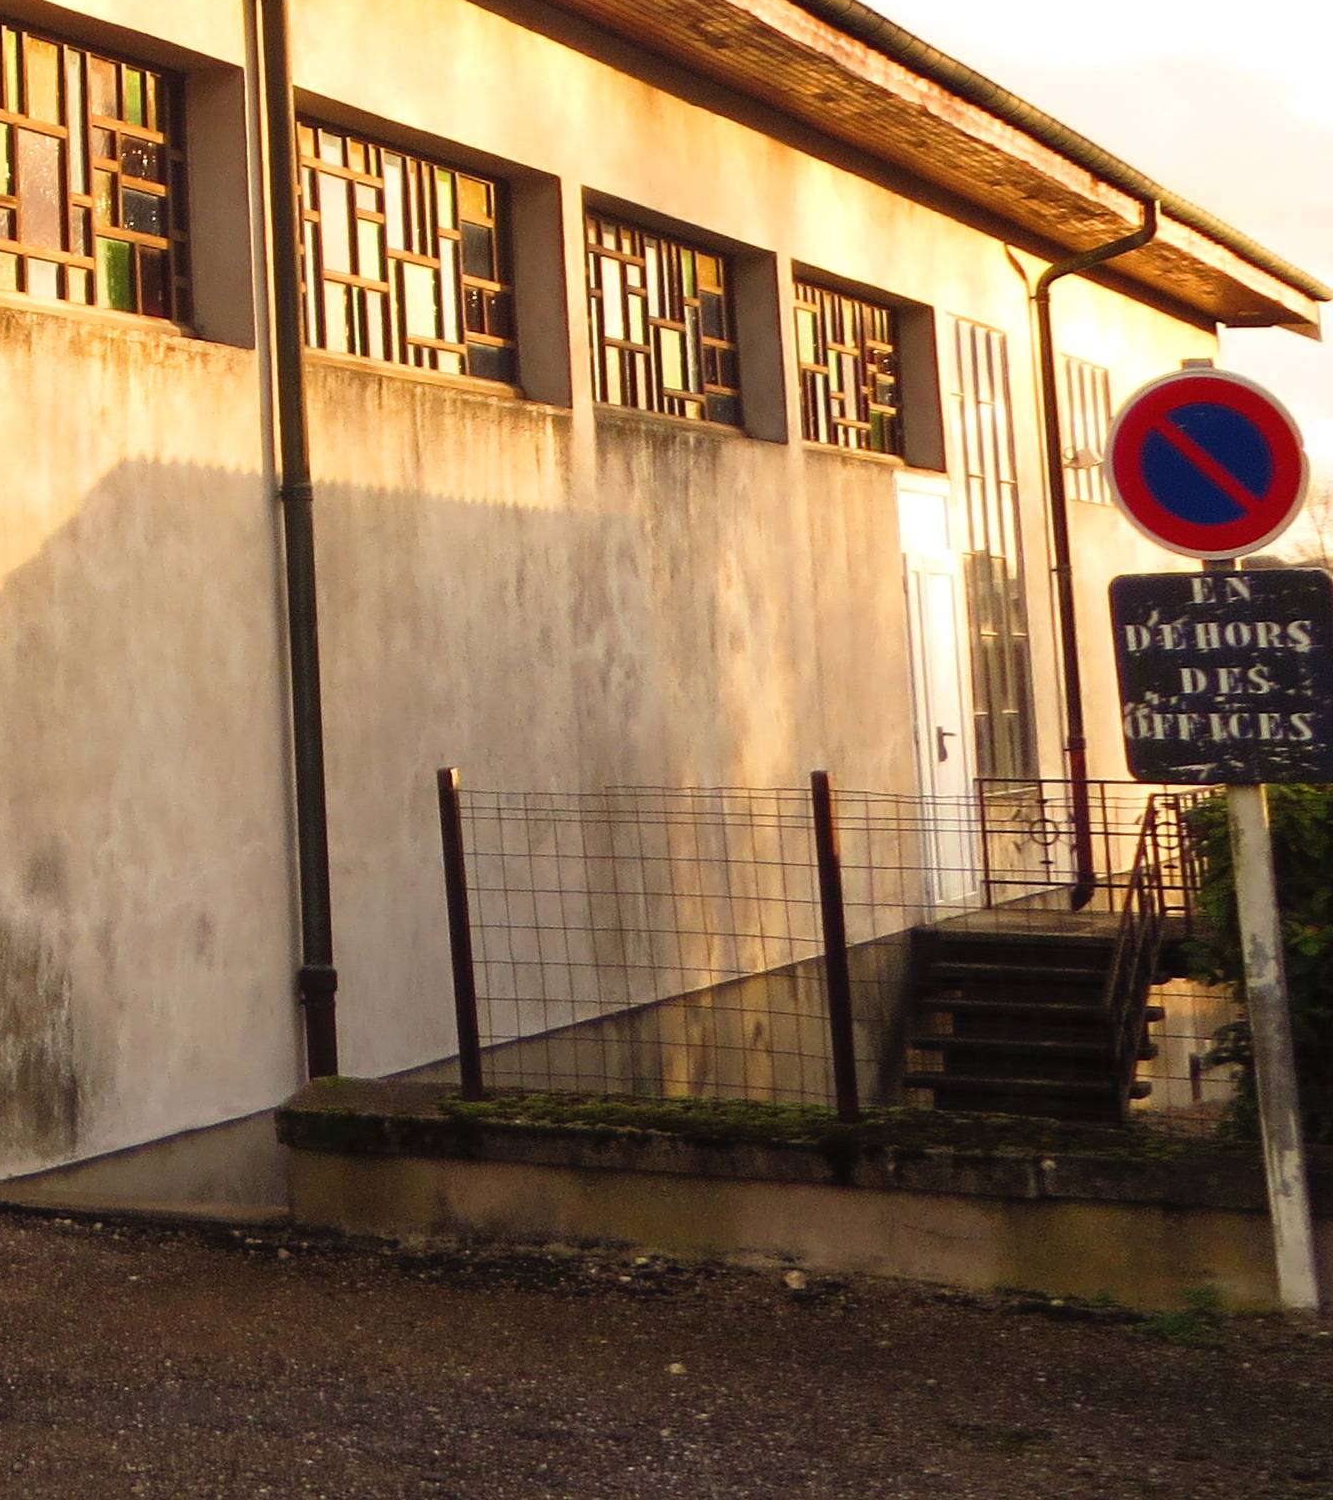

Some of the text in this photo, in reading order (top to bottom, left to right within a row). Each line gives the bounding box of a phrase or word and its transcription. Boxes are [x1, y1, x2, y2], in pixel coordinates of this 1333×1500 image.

[1191, 576, 1252, 603] EN
[1125, 620, 1313, 651] DEHORS
[1180, 665, 1271, 694] DES
[1124, 710, 1315, 740] OFFICES
